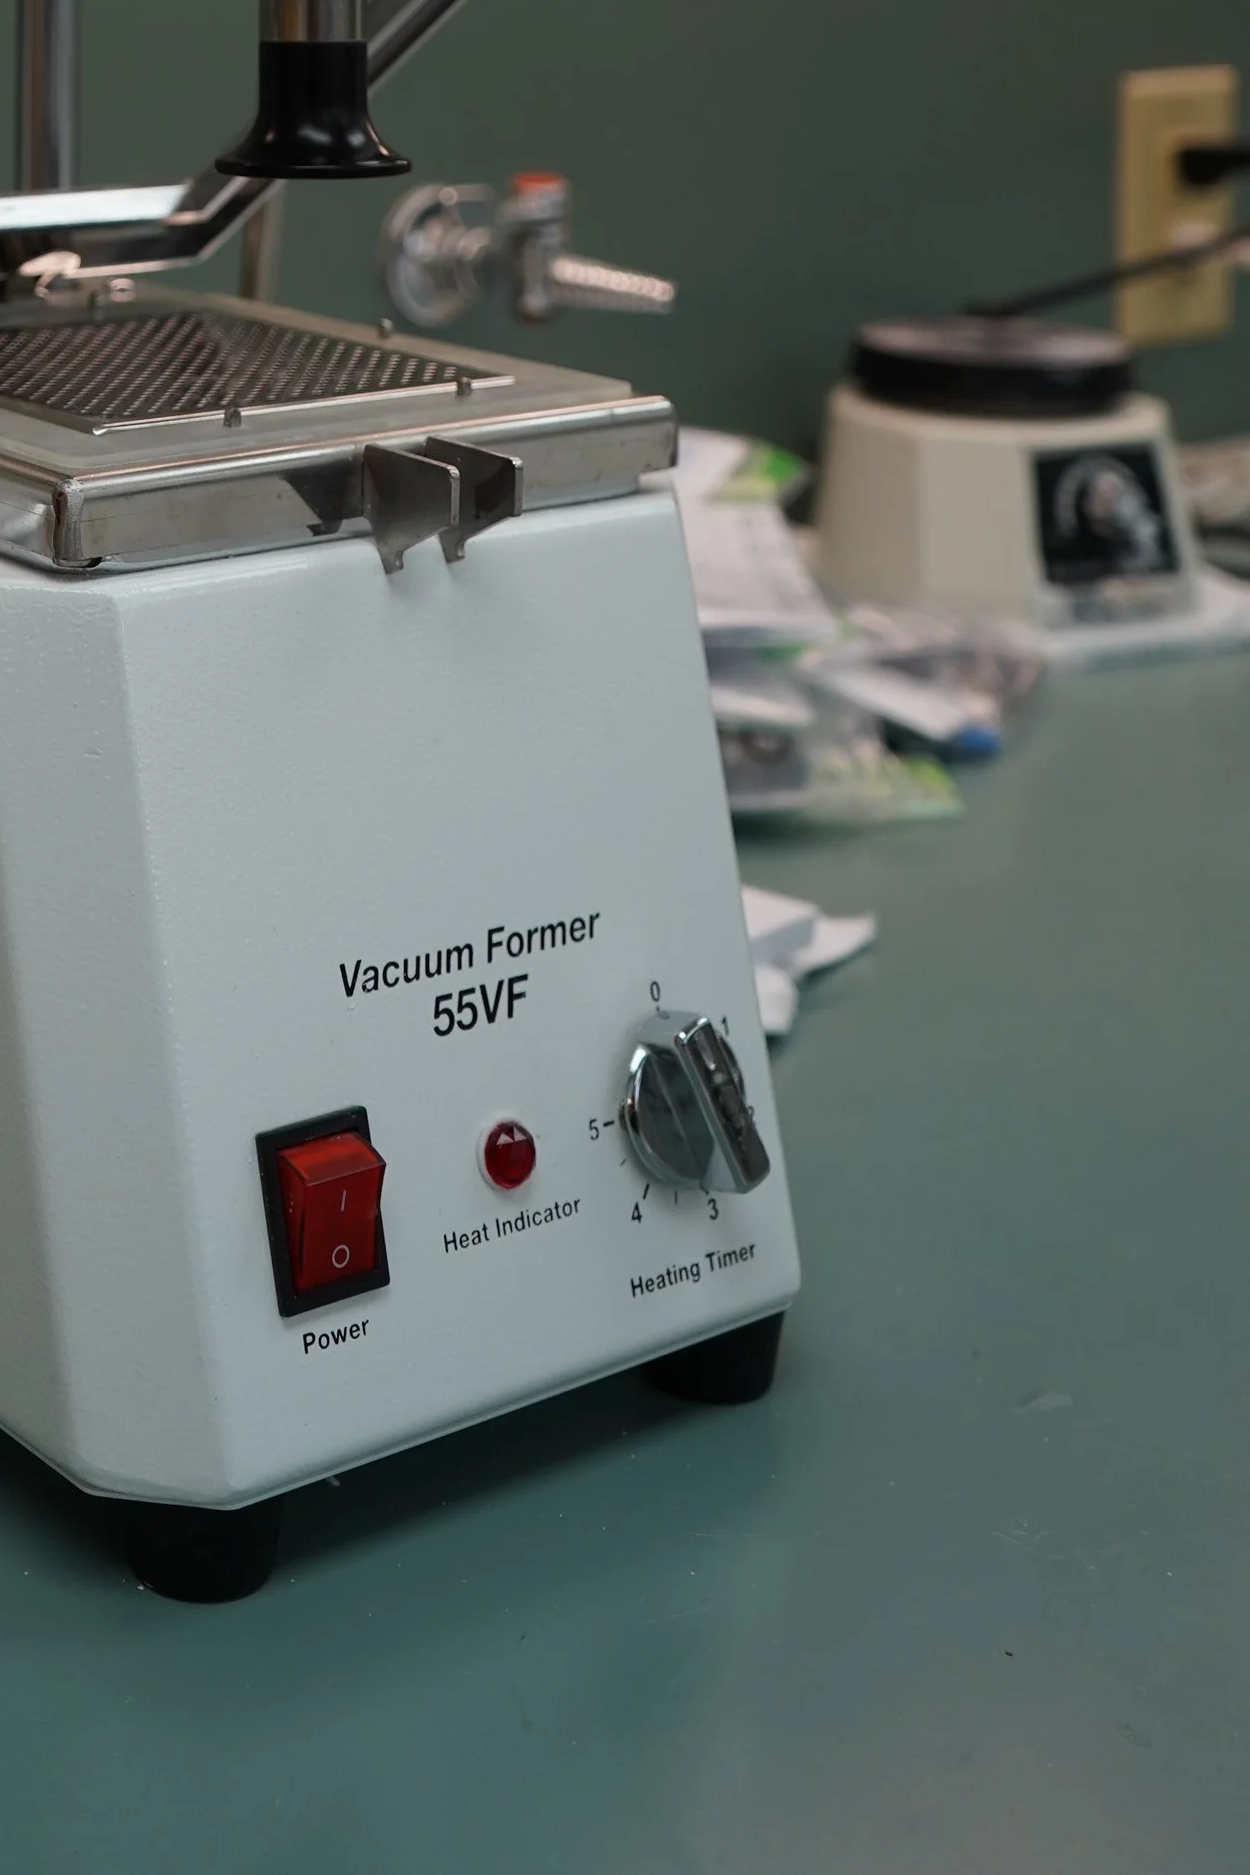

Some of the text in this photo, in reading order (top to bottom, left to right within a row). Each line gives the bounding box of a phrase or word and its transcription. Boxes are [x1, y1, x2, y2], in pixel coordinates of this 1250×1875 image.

[339, 912, 600, 998] Vacuum Former
[433, 973, 529, 1037] 55VF
[650, 980, 661, 1002] 0
[720, 1015, 730, 1036] 1
[588, 1118, 600, 1141] 5
[631, 1201, 643, 1224] 4
[707, 1197, 719, 1221] 3
[443, 1198, 581, 1253] Heat Indicator
[630, 1243, 756, 1298] Heating Timer
[302, 1319, 370, 1355] Power
